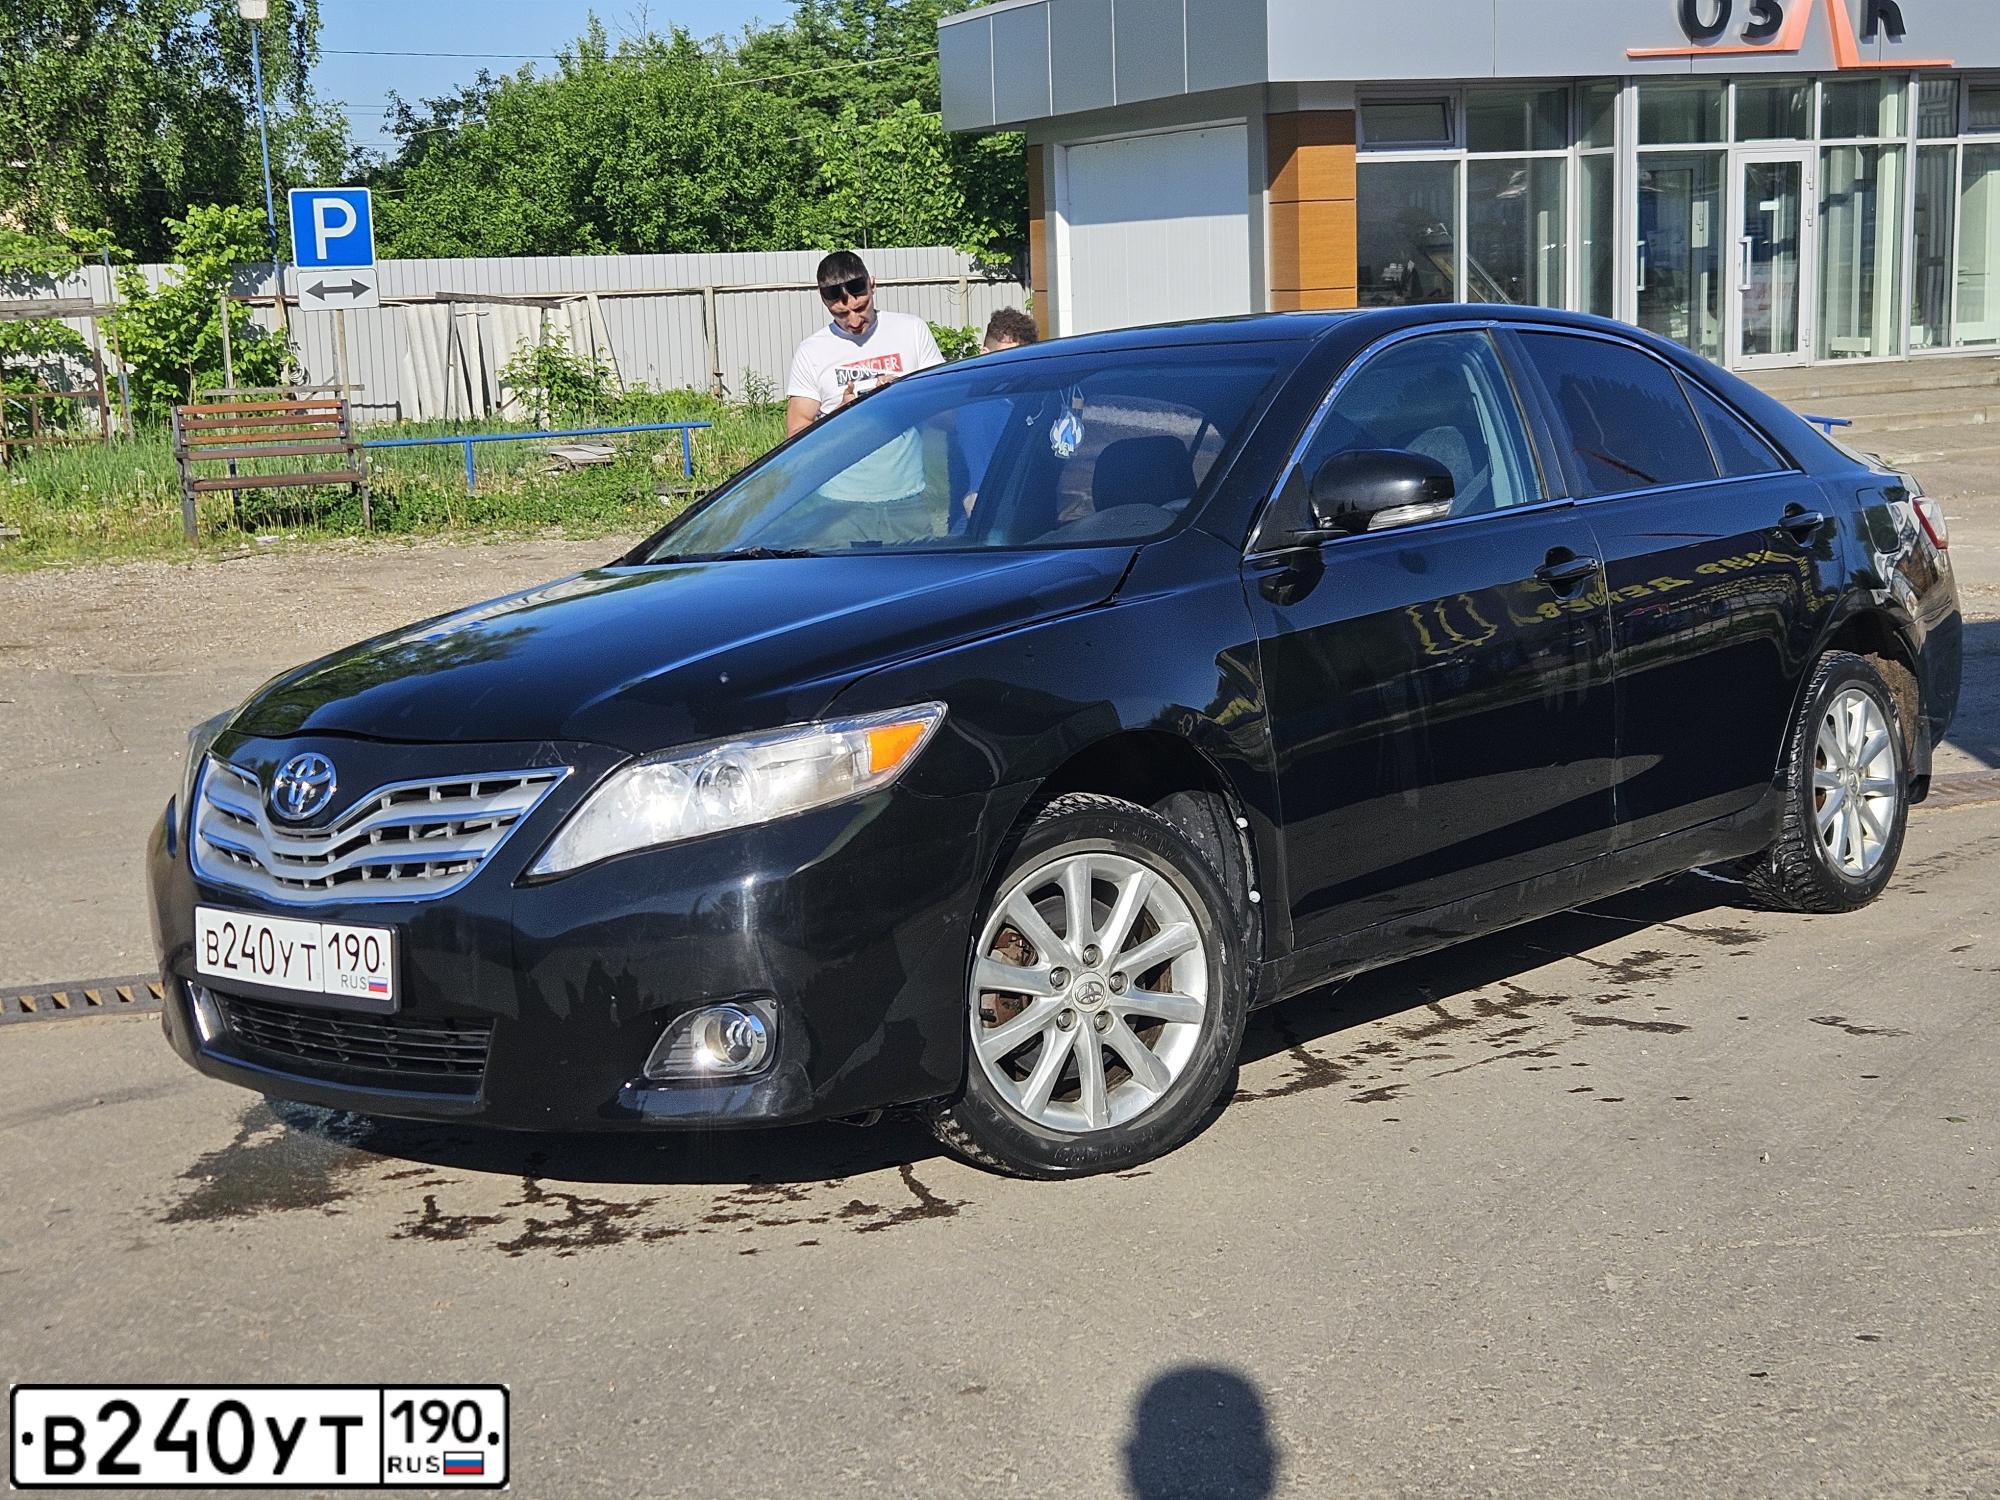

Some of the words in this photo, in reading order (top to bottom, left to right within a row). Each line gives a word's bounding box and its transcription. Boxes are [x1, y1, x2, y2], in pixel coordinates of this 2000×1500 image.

[312, 198, 357, 260] P
[206, 921, 317, 982] В240УТ
[328, 932, 380, 973] 190
[341, 974, 367, 990] RUS
